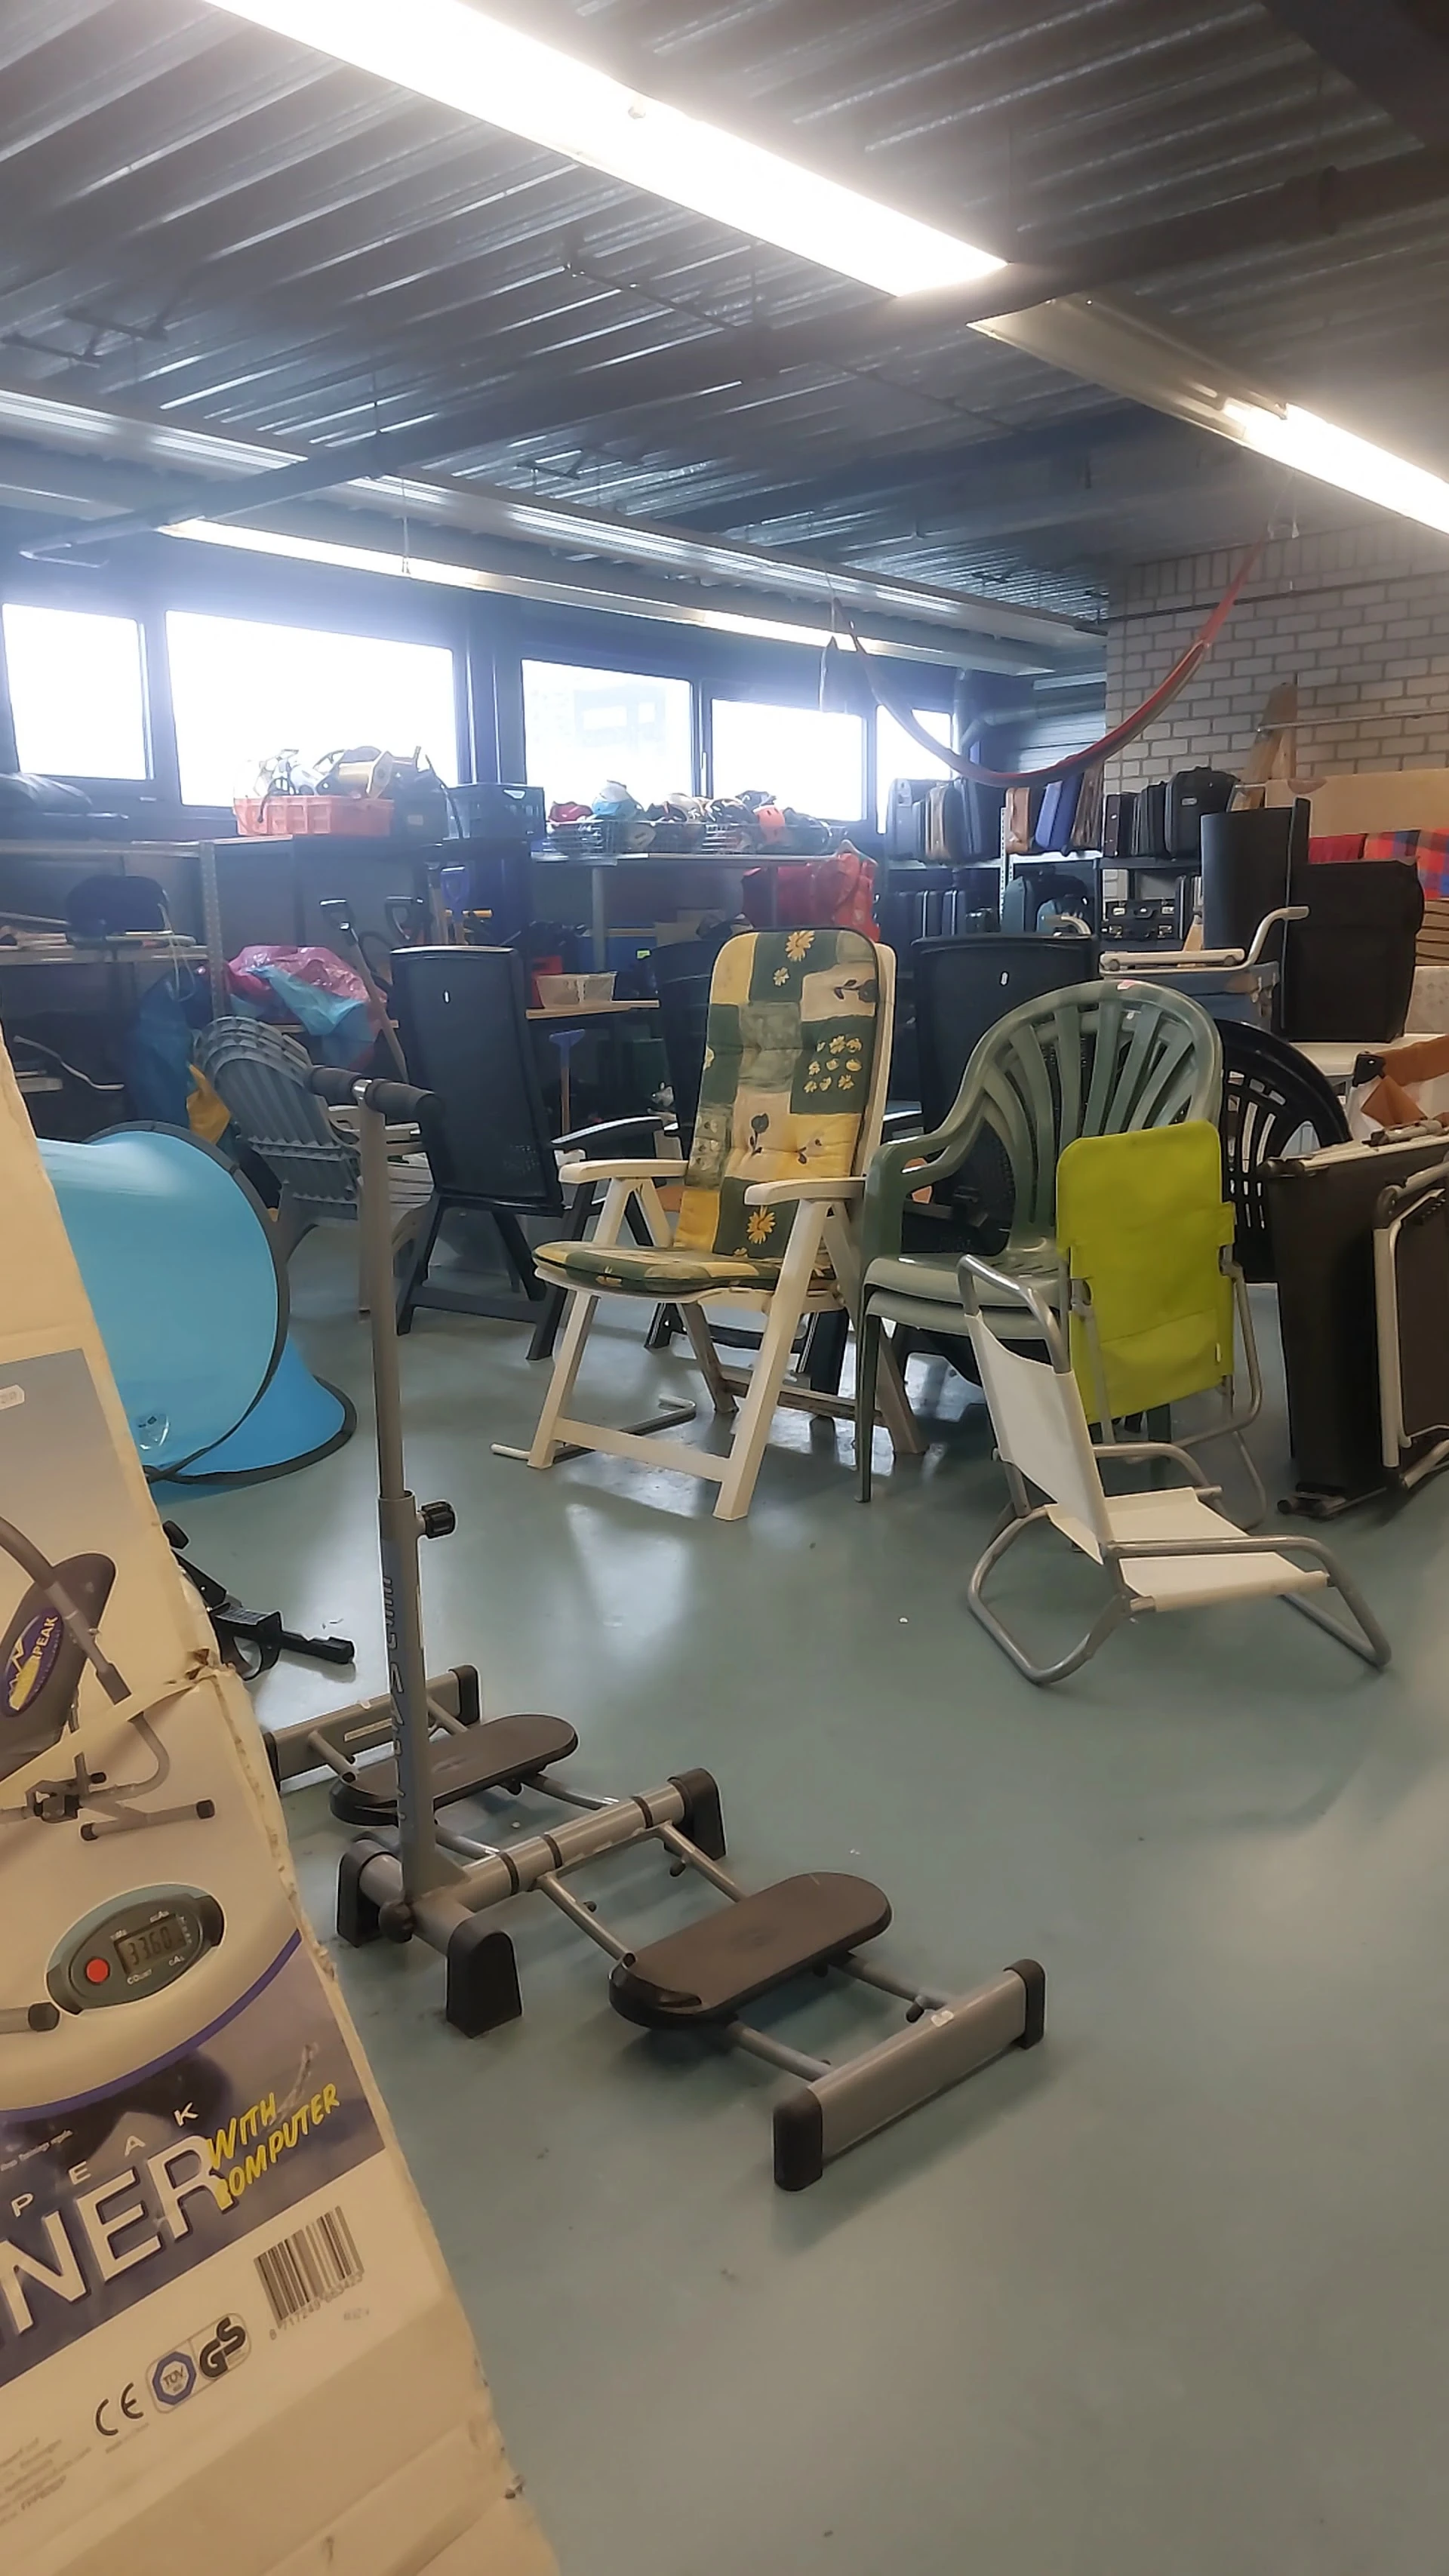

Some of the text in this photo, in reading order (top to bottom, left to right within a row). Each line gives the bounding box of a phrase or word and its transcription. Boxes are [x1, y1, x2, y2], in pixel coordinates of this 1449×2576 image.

[206, 2091, 276, 2170] WITH
[199, 2316, 246, 2378] GS
[95, 2382, 145, 2436] CE
